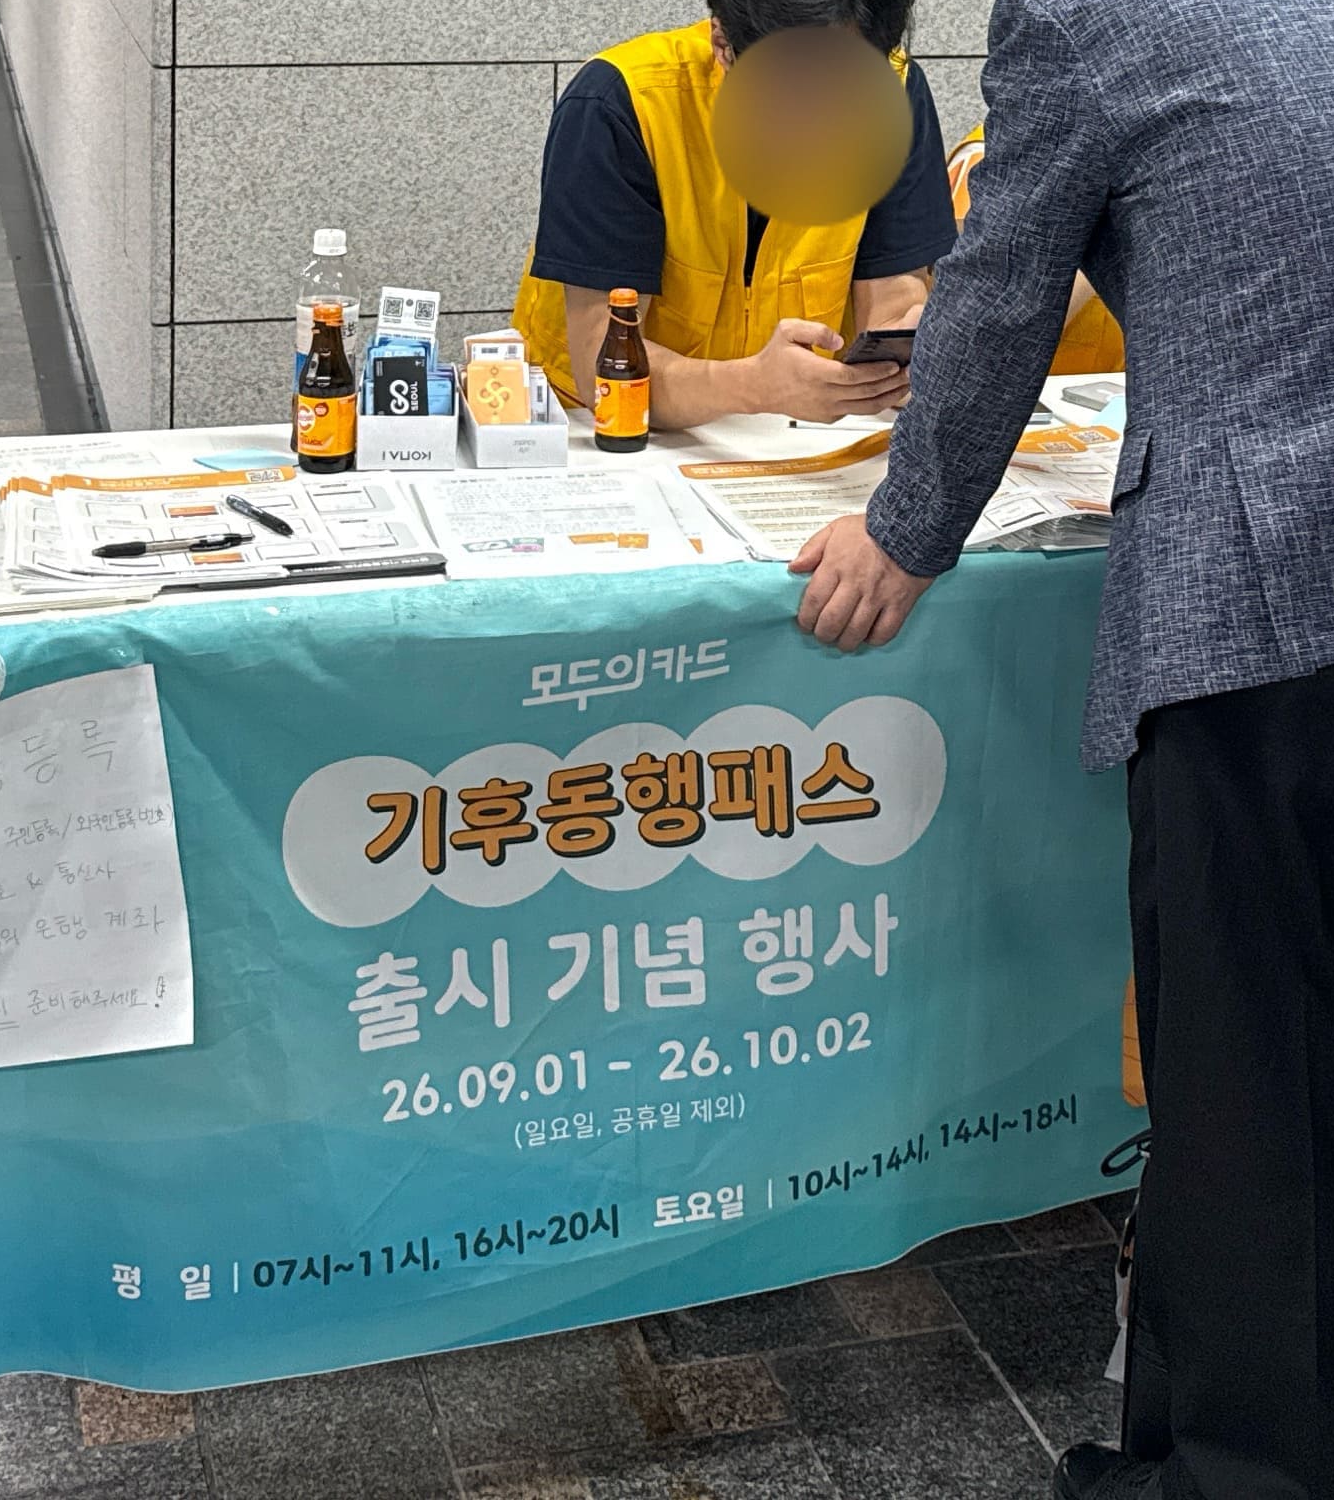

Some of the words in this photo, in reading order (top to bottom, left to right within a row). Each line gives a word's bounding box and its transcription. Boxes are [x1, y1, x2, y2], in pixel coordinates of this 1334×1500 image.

[411, 381, 419, 411] SEOUL
[522, 638, 730, 711] 모두의카드
[365, 741, 881, 875] 기후동행패스
[55, 861, 116, 884] 통신사
[35, 916, 89, 940] 은행
[105, 904, 165, 934] 계좌
[348, 937, 511, 1052] 출시
[547, 915, 706, 1012] 기념
[739, 892, 900, 997] 행사
[382, 1051, 589, 1124] 26.09.01
[658, 1011, 873, 1083] 26.10.02
[513, 1112, 603, 1151] (일요일,
[610, 1100, 683, 1136] 공휴일
[690, 1091, 747, 1127] 제외)
[252, 1238, 440, 1289] 07시~11시,
[455, 1203, 620, 1264] 16시~20시
[653, 1183, 745, 1229] 토요일
[788, 1132, 929, 1202] 10시~14시,
[940, 1094, 1078, 1152] 14시~18시
